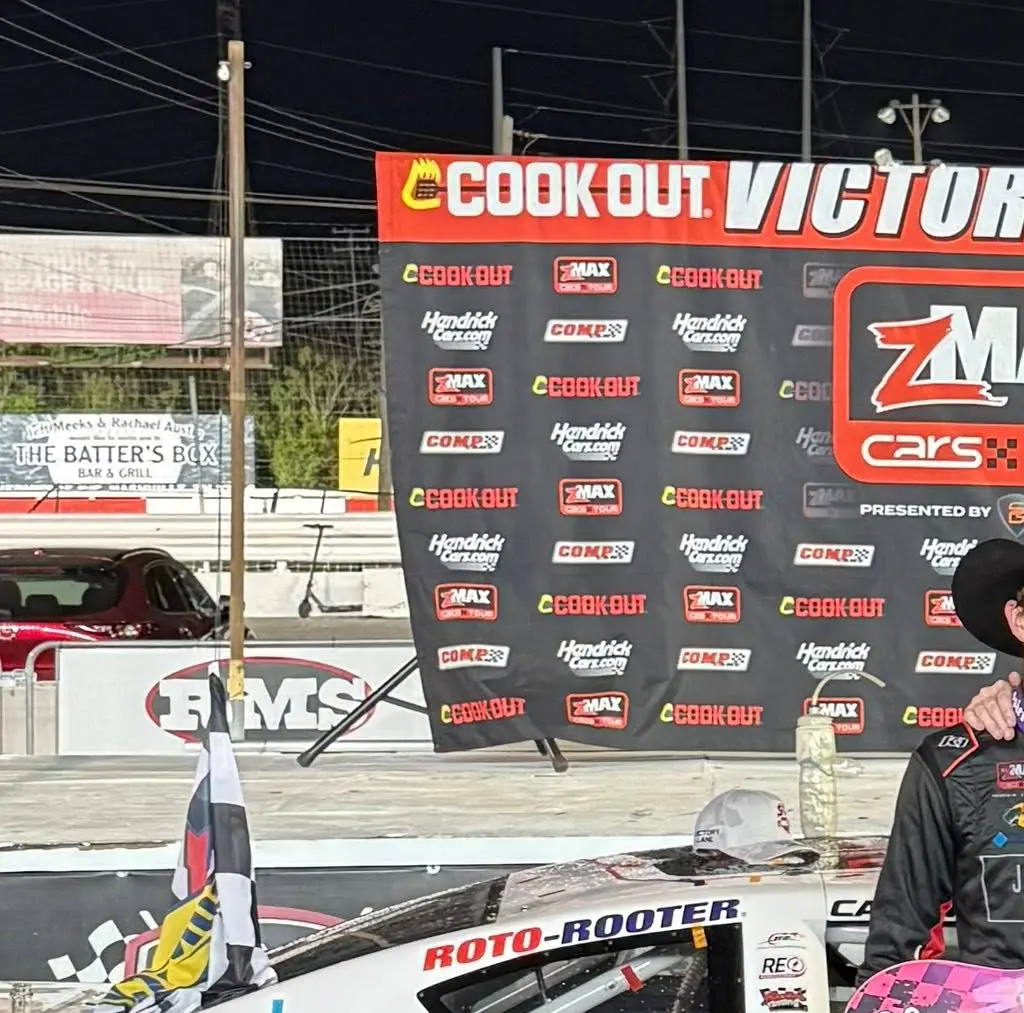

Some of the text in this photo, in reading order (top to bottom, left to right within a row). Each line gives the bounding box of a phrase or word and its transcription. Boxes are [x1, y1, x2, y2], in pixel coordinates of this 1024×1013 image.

[447, 160, 712, 219] COOK OUT
[417, 264, 513, 286] COOK OUT
[422, 311, 498, 332] Hendrick
[550, 323, 608, 338] COMP
[548, 376, 641, 397] COOK OUT
[551, 423, 626, 444] Hendrick
[16, 445, 56, 464] THE
[64, 445, 165, 464] BATTER'S
[78, 467, 101, 479] BAR
[119, 468, 153, 479] GRILL
[676, 488, 763, 510] COOK OUT
[860, 504, 992, 518] PRESENTED BY
[558, 545, 613, 560] COMP
[680, 534, 749, 553] Hendrick
[800, 547, 855, 561] COMP
[553, 595, 647, 615] COOK OUT
[796, 643, 871, 663] Hendrick
[422, 898, 742, 972] ROTO-ROOTER
